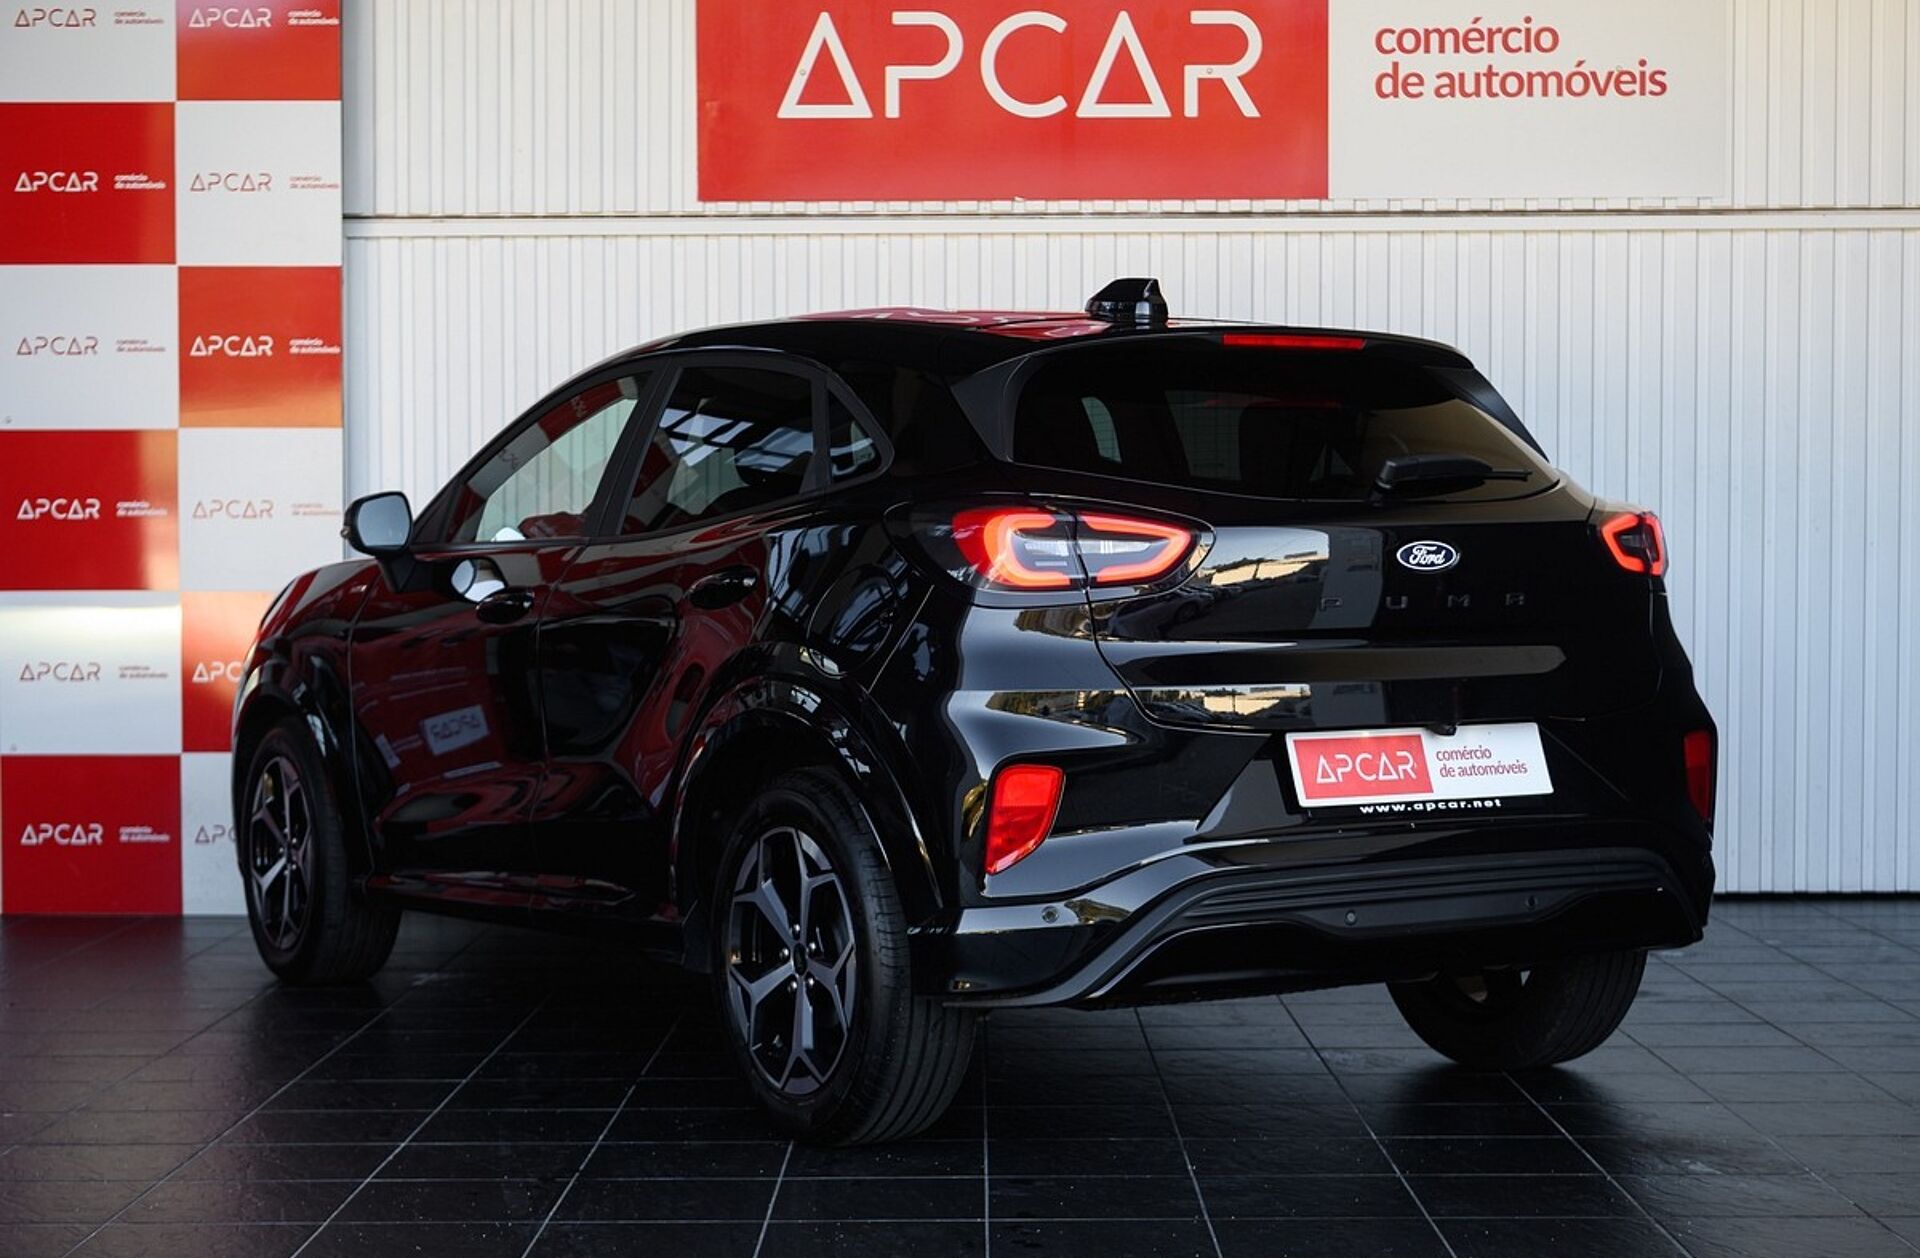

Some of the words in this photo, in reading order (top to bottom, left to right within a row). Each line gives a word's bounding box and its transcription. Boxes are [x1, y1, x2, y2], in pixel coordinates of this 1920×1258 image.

[14, 8, 97, 27] APCAR
[189, 8, 272, 28] APCAR
[1375, 16, 1559, 54] comércio
[777, 11, 1262, 118] APCAR
[1375, 61, 1424, 98] de
[1433, 59, 1667, 98] automóveis
[14, 172, 98, 192] APCAR
[189, 172, 272, 192] APCAR
[17, 336, 98, 355] APCAR
[190, 335, 273, 356] APCAR
[17, 498, 100, 519] APCAR
[192, 499, 274, 519] APCAR
[1408, 545, 1446, 565] Ford
[19, 663, 101, 682] APCAR
[1436, 745, 1492, 762] comércio
[1315, 750, 1418, 784] APCAR
[1439, 763, 1456, 779] de
[1457, 759, 1528, 778] automóveis
[1359, 798, 1502, 815] www.apcar.net
[20, 823, 103, 845] APCAR
